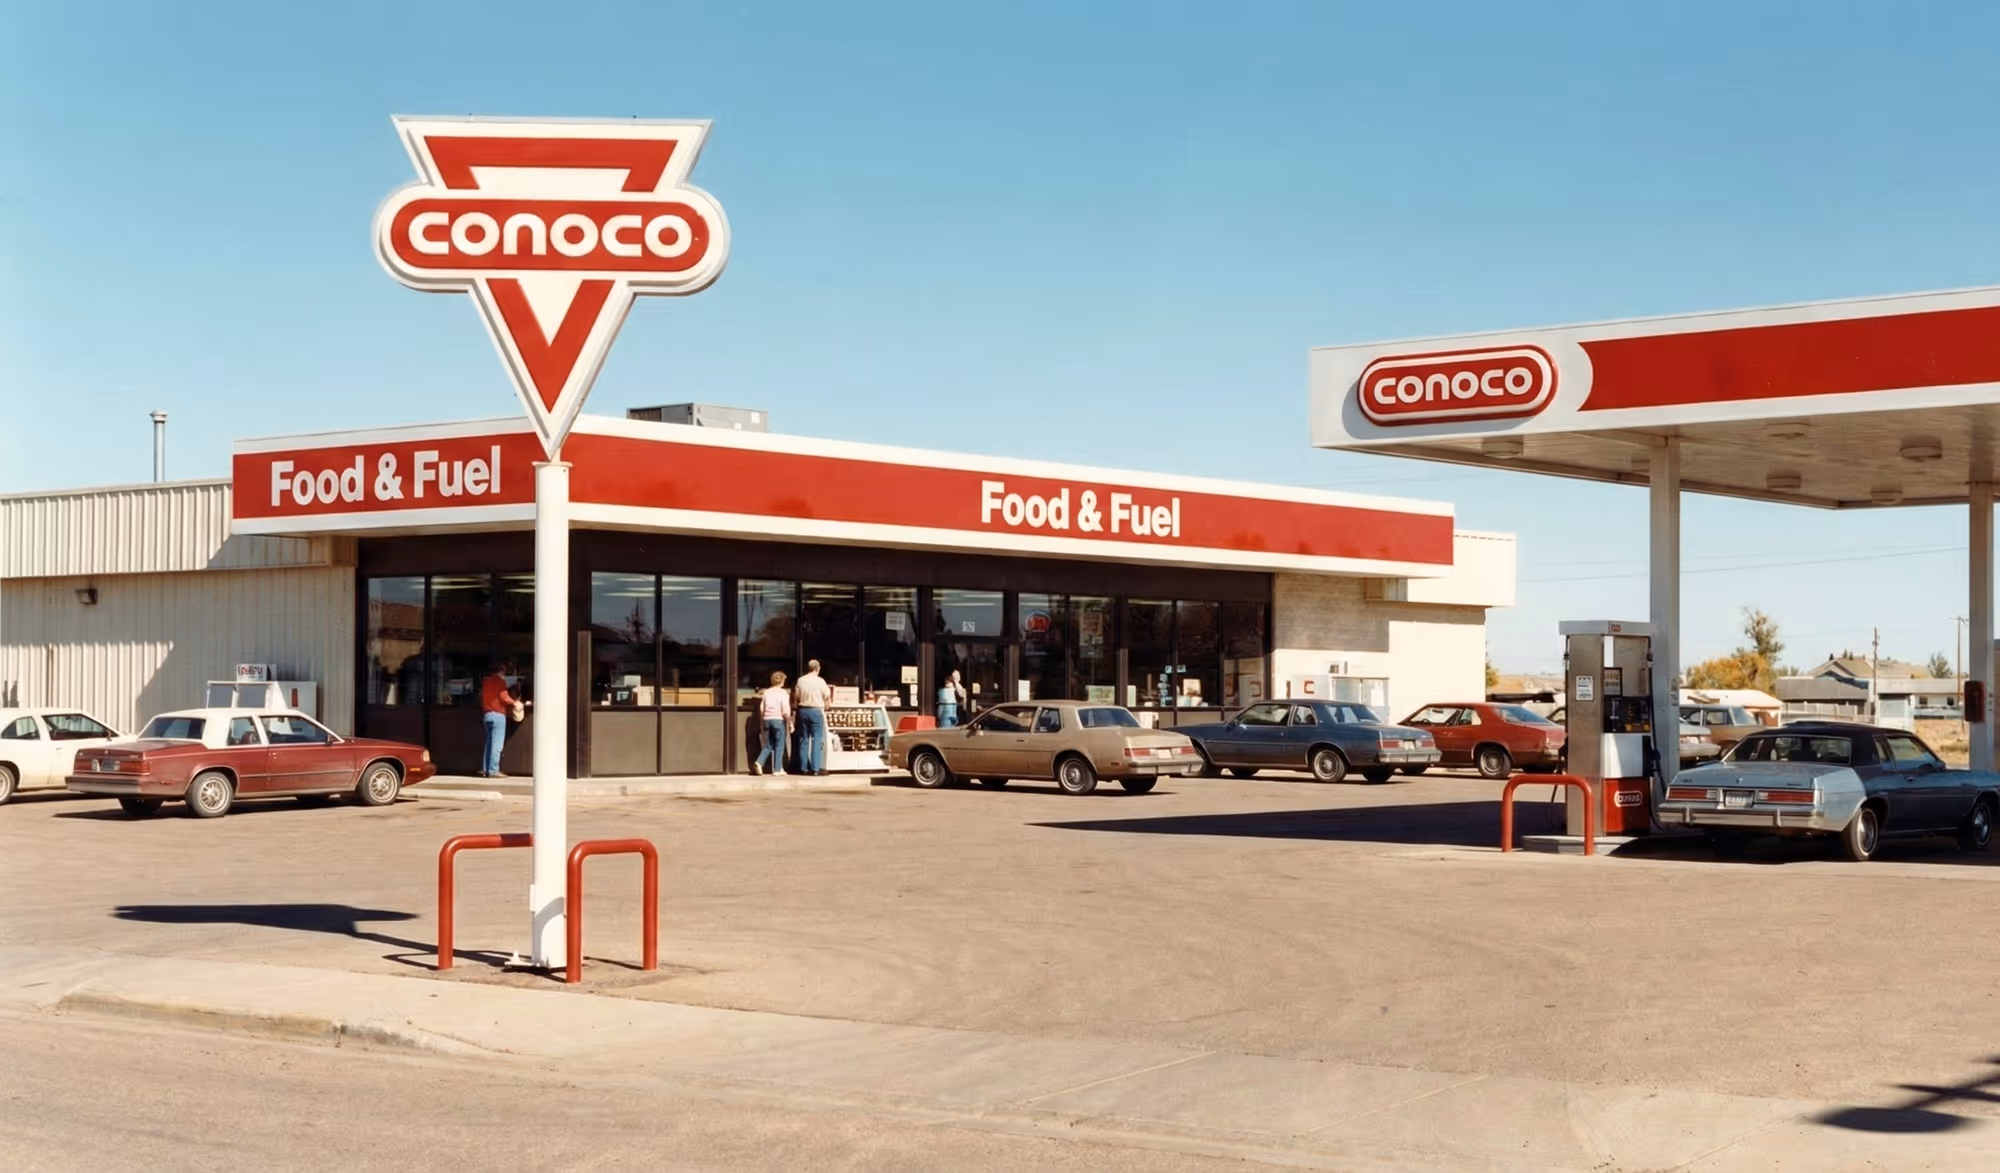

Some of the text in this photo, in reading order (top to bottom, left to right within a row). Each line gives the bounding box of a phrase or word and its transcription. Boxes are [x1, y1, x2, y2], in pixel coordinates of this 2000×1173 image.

[271, 445, 501, 507] Food & Fuel
[981, 480, 1181, 538] Food & Fuel
